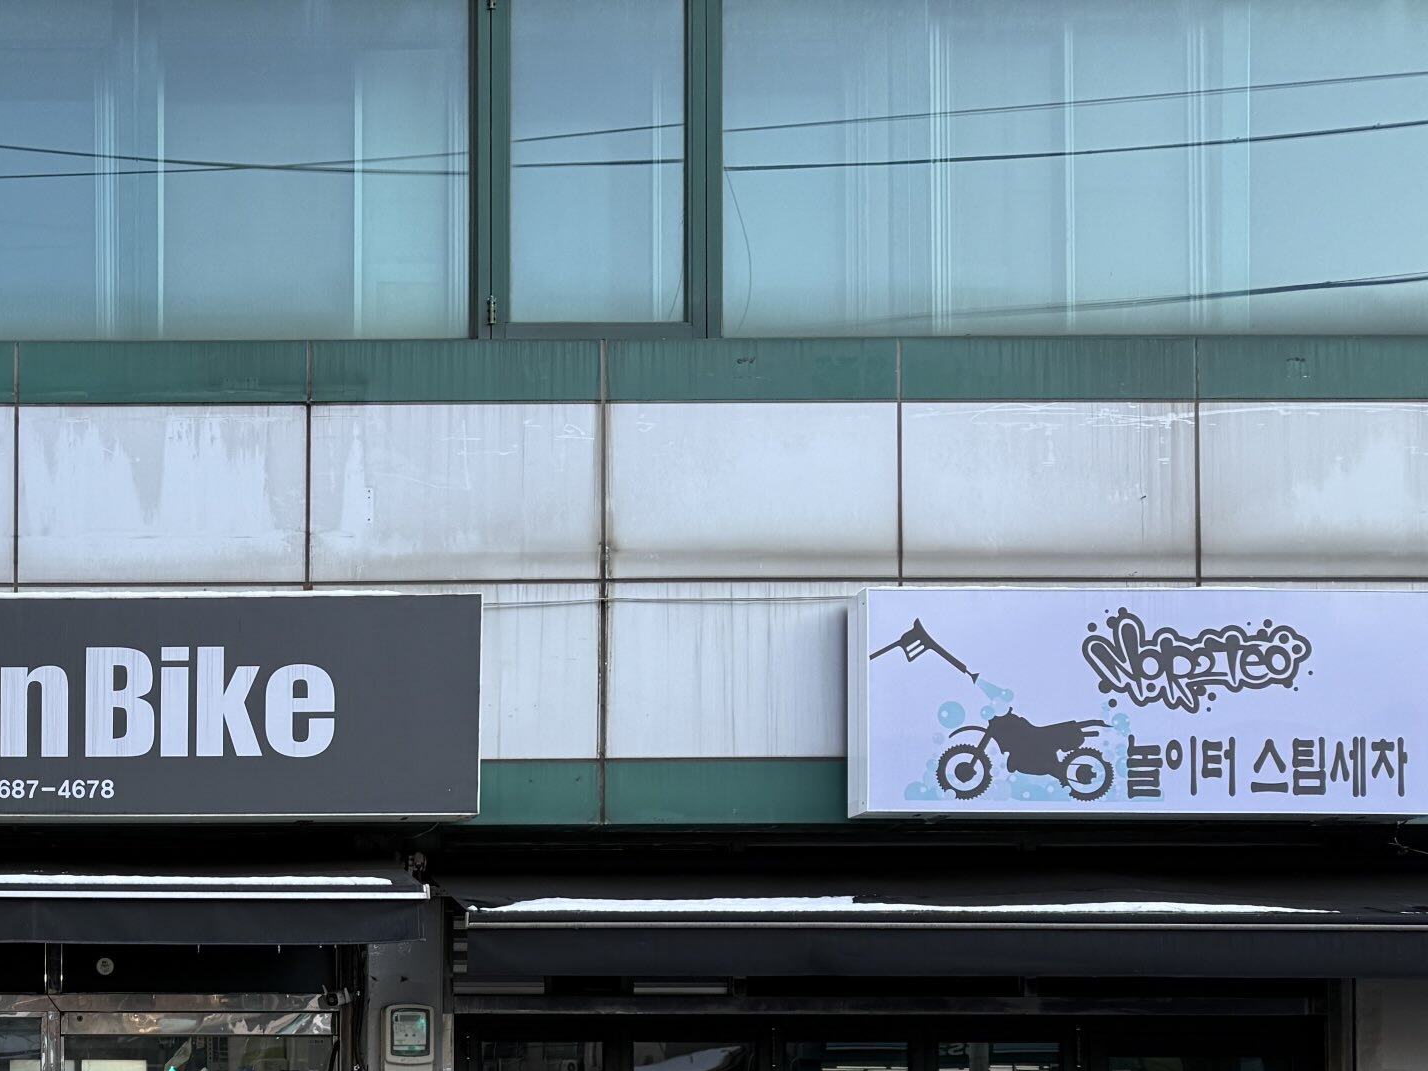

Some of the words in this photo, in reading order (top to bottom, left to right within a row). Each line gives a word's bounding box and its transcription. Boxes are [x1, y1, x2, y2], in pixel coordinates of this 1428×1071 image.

[85, 647, 337, 758] Bike
[1127, 735, 1236, 799] 놀이터
[1251, 736, 1409, 798] 스팀세차
